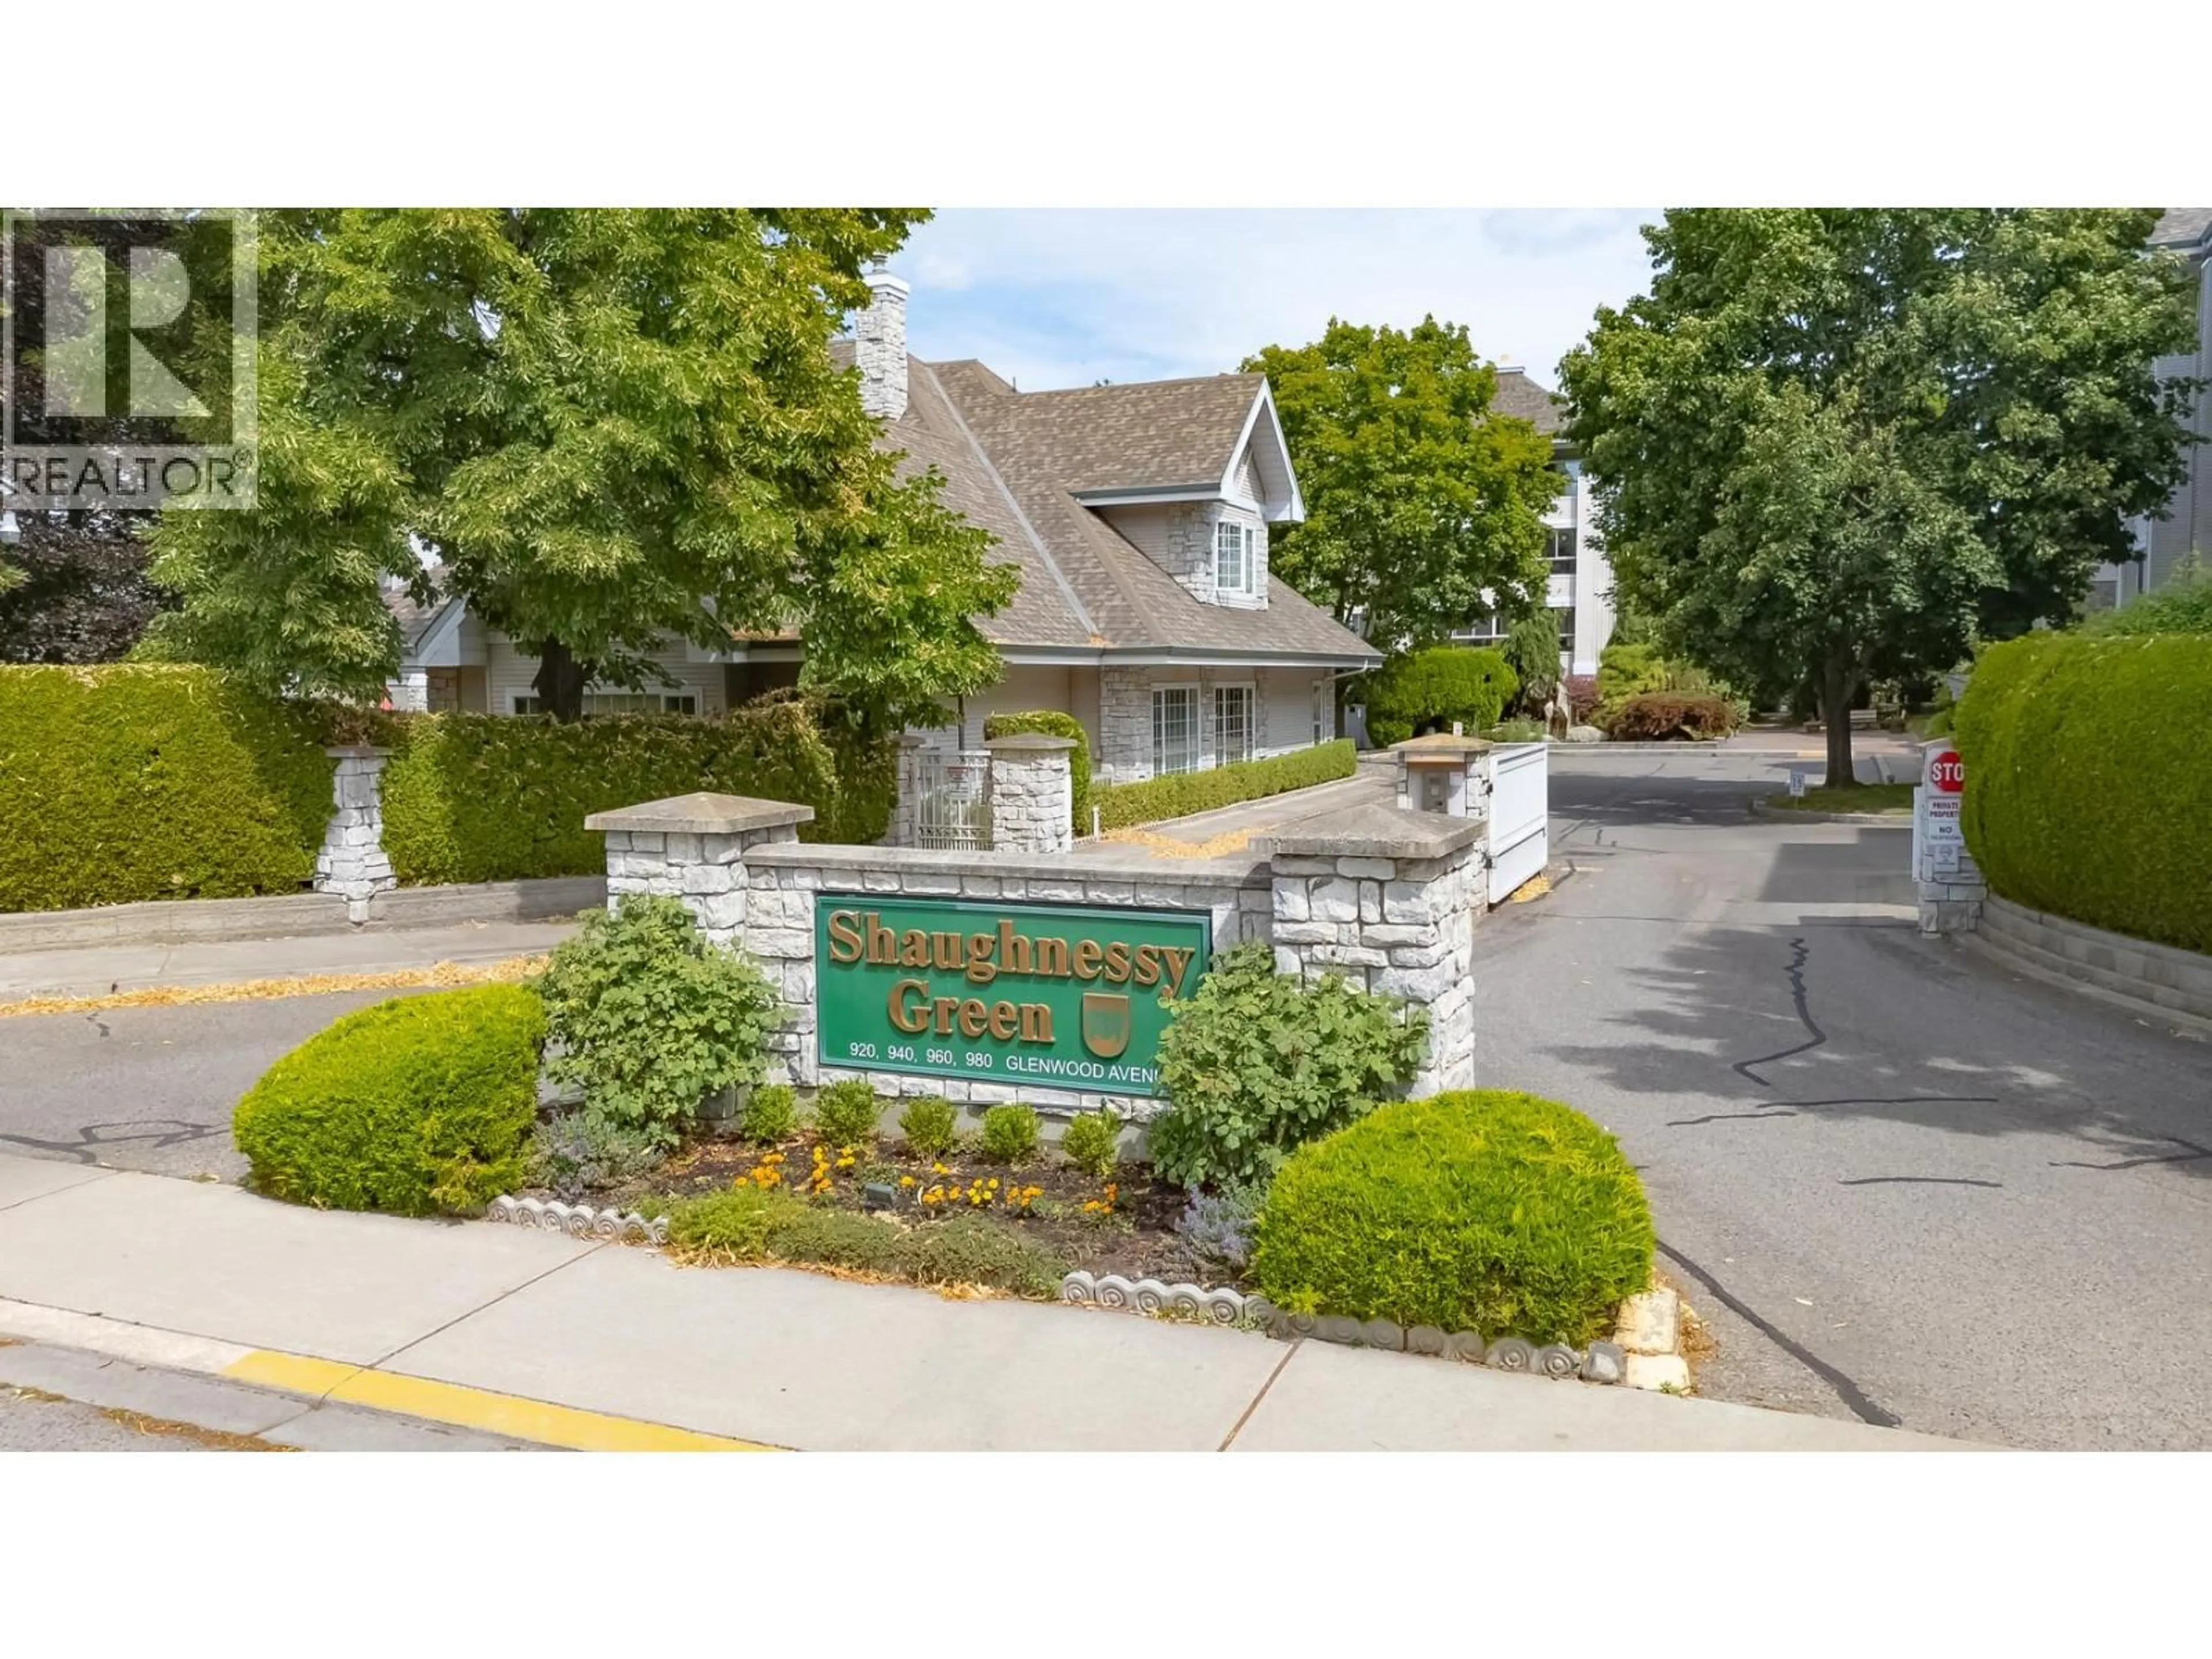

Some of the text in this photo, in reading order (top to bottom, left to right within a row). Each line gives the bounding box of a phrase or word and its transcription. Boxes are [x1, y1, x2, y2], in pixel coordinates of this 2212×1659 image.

[1932, 763, 1964, 782] STO
[827, 909, 1195, 998] Shaughnessy
[888, 979, 1056, 1044] Green
[850, 1042, 1158, 1084] 920, 940, 960, 980 GLENWOOD AVEN
